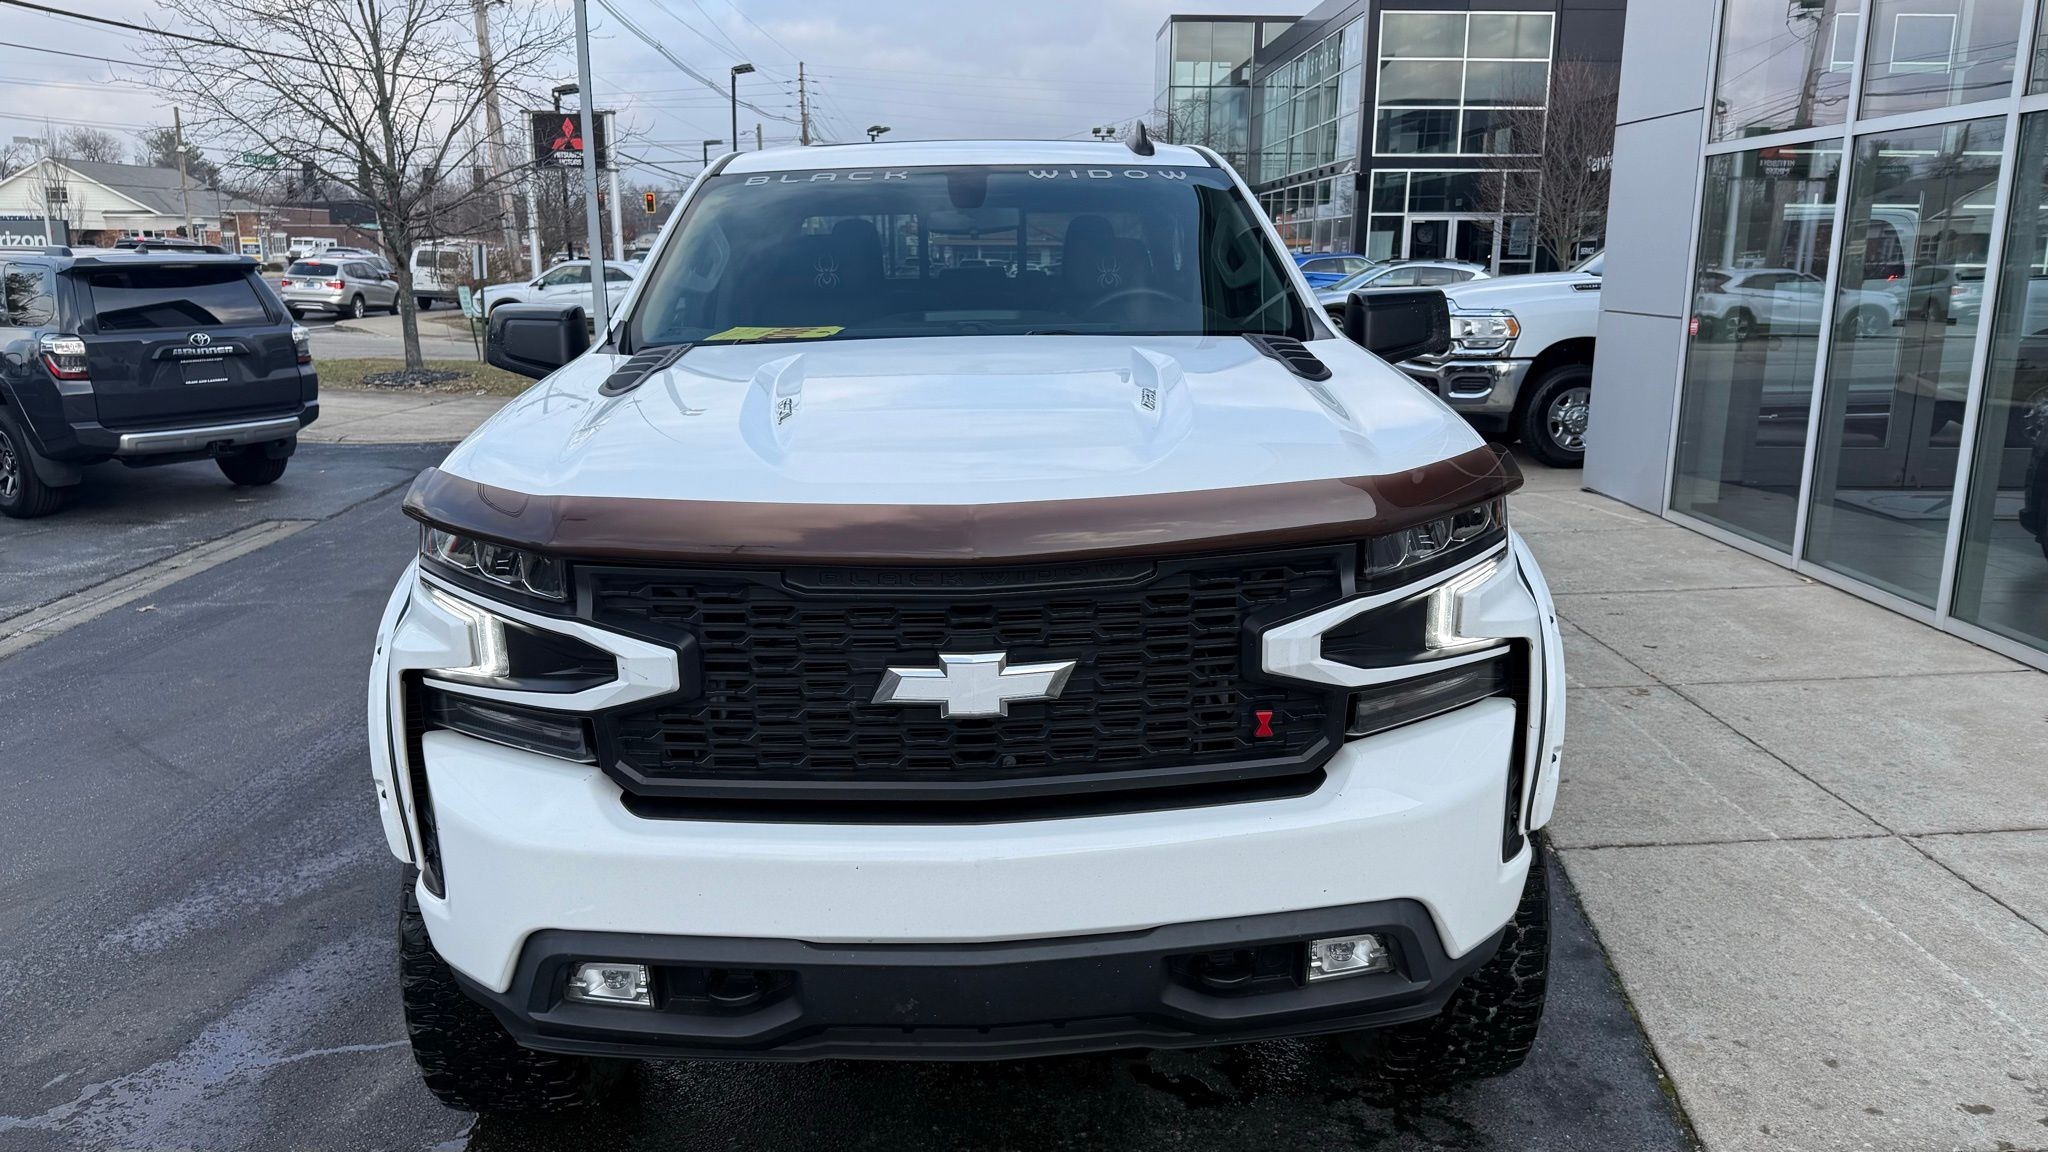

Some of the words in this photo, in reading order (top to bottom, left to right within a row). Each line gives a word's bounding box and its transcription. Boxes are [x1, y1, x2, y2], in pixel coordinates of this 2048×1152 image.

[1586, 151, 1612, 172] Servi
[744, 170, 909, 186] BLACK
[1028, 169, 1187, 180] WIDOW
[0, 231, 47, 247] rizon
[818, 570, 964, 586] BLACK
[978, 563, 1124, 584] WIDOW
